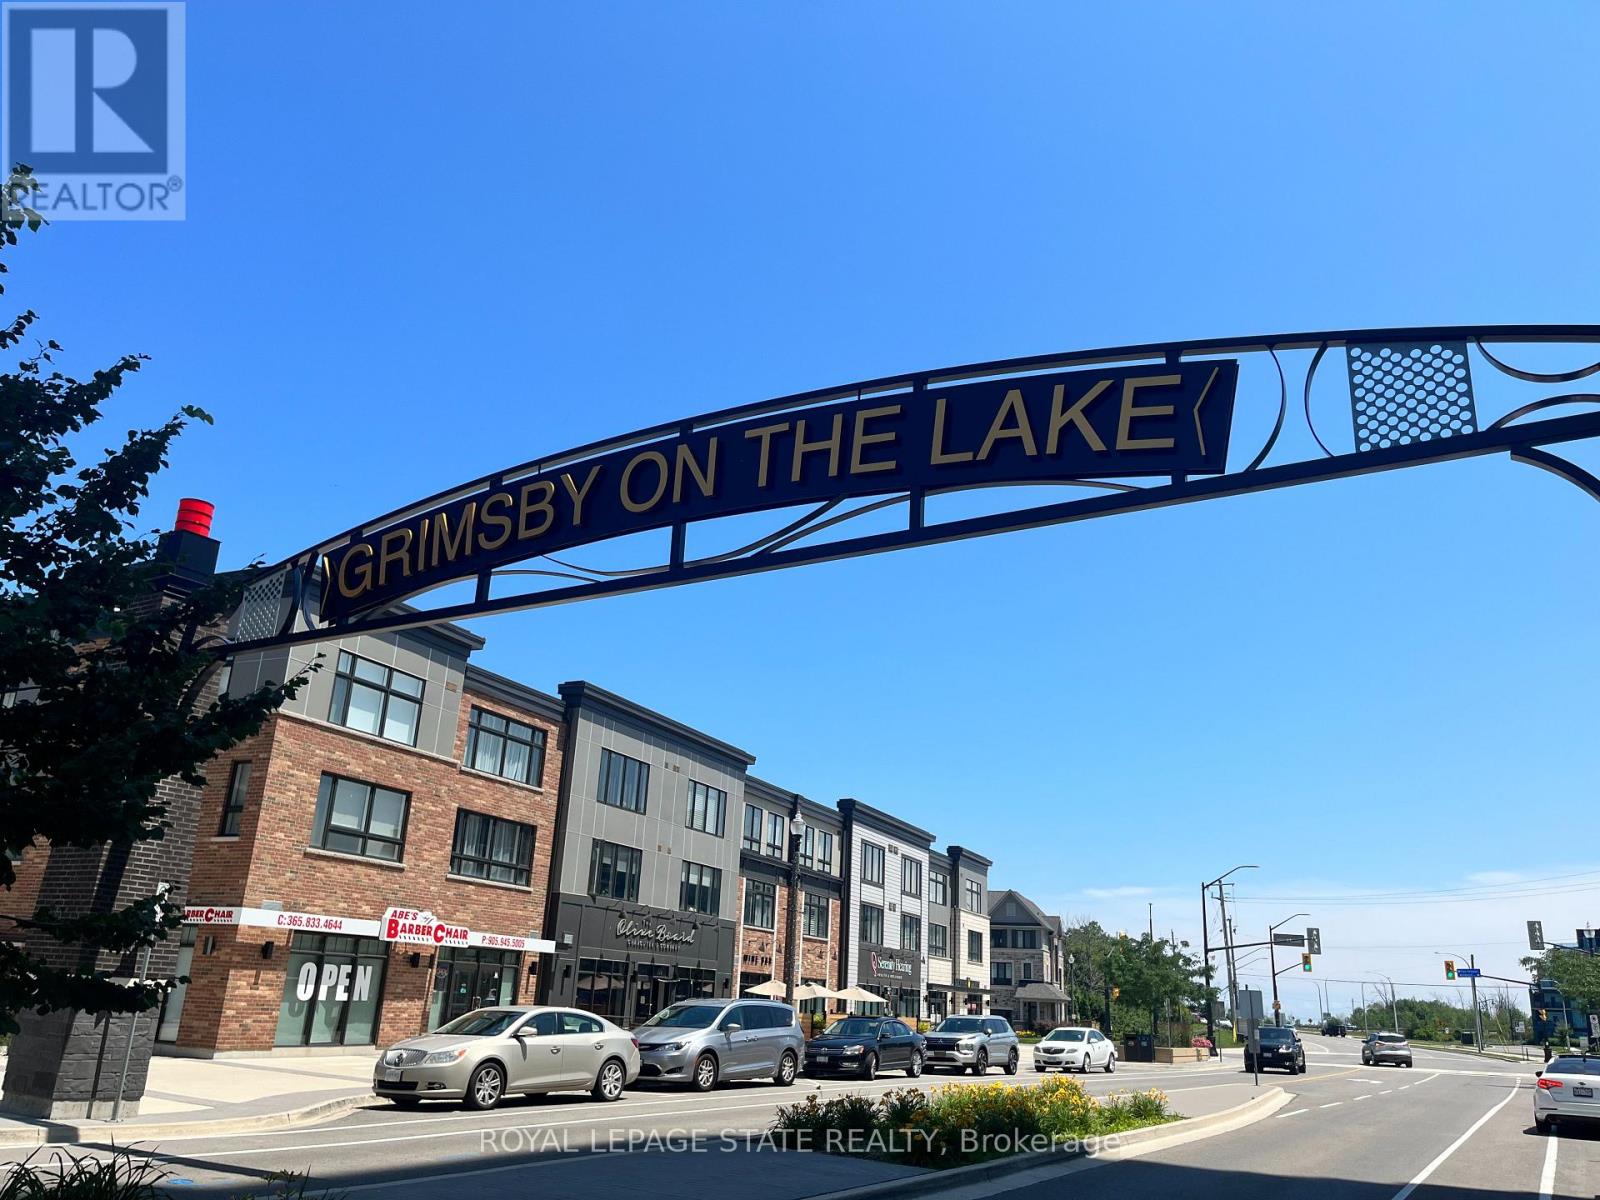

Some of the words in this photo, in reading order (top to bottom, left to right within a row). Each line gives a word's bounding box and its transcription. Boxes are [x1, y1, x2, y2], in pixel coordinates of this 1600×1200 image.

[338, 465, 602, 598] GRIMSBY
[619, 437, 719, 513] ON
[744, 404, 901, 488] THE
[930, 374, 1182, 465] LAKE
[205, 908, 234, 922] CHAIR
[277, 914, 343, 930] C:365.833.4644
[391, 910, 418, 921] ABE'S
[386, 918, 433, 938] BARBER
[433, 924, 469, 943] CHAIR
[296, 962, 373, 1002] OPEN
